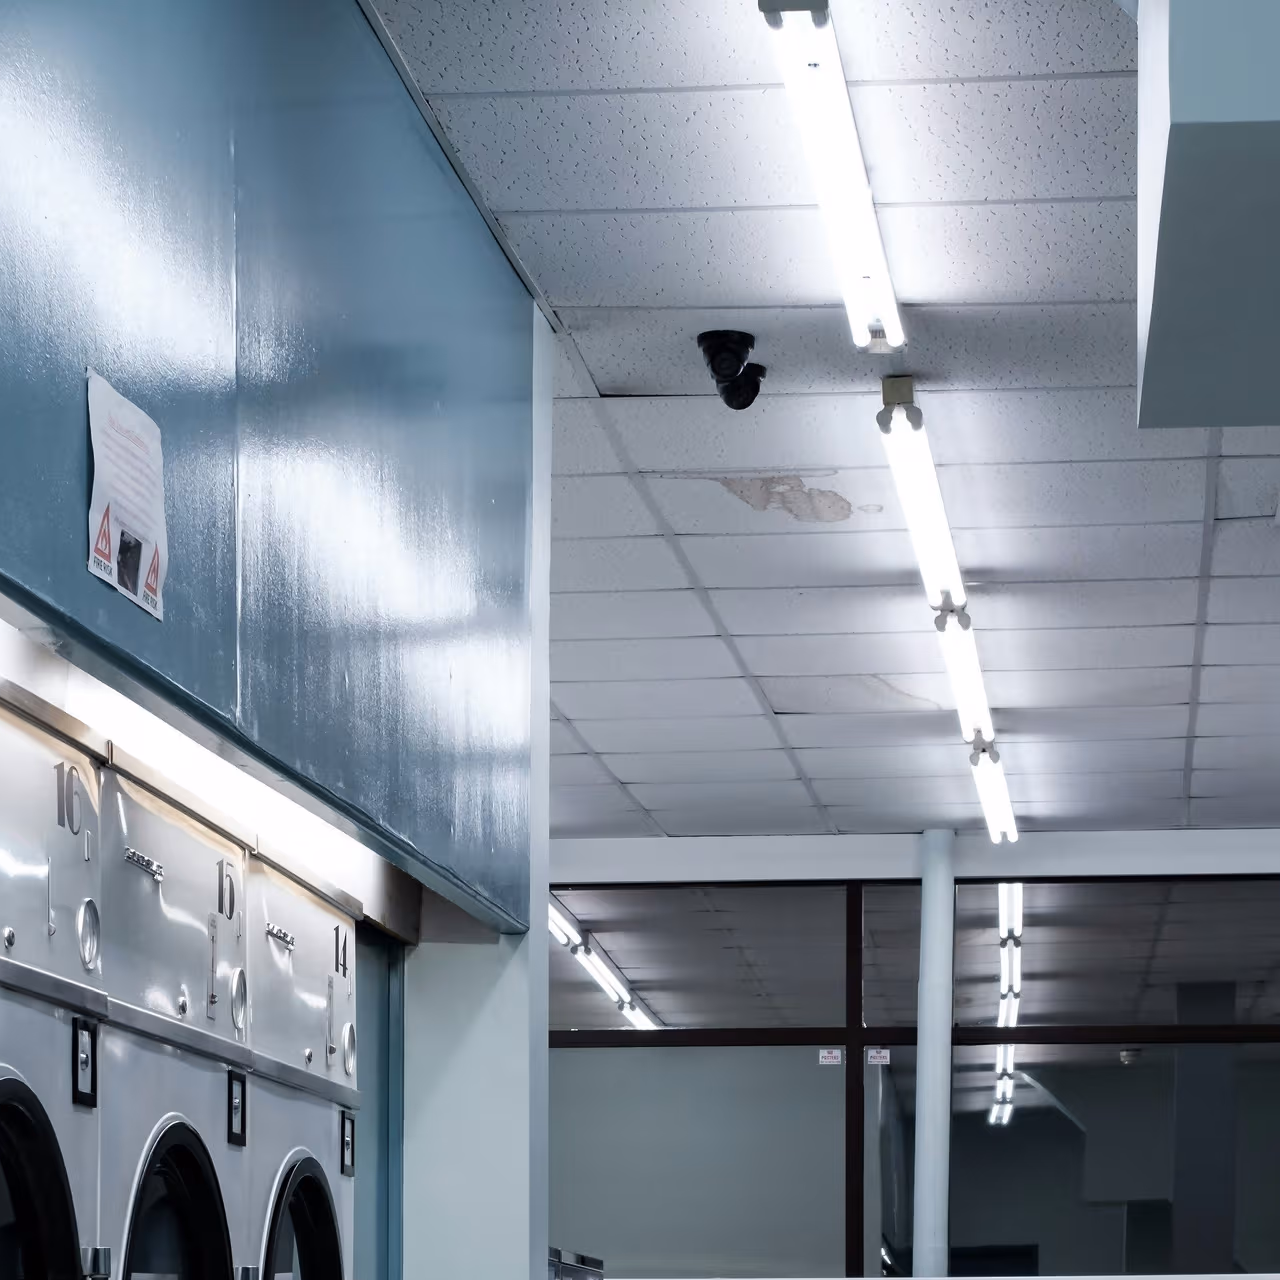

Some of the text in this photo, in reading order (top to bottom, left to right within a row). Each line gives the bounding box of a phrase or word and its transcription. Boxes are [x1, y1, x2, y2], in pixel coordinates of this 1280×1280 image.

[93, 555, 113, 578] FIRE RISK
[53, 761, 81, 836] 16
[216, 859, 235, 920] 15
[333, 925, 348, 979] 14
